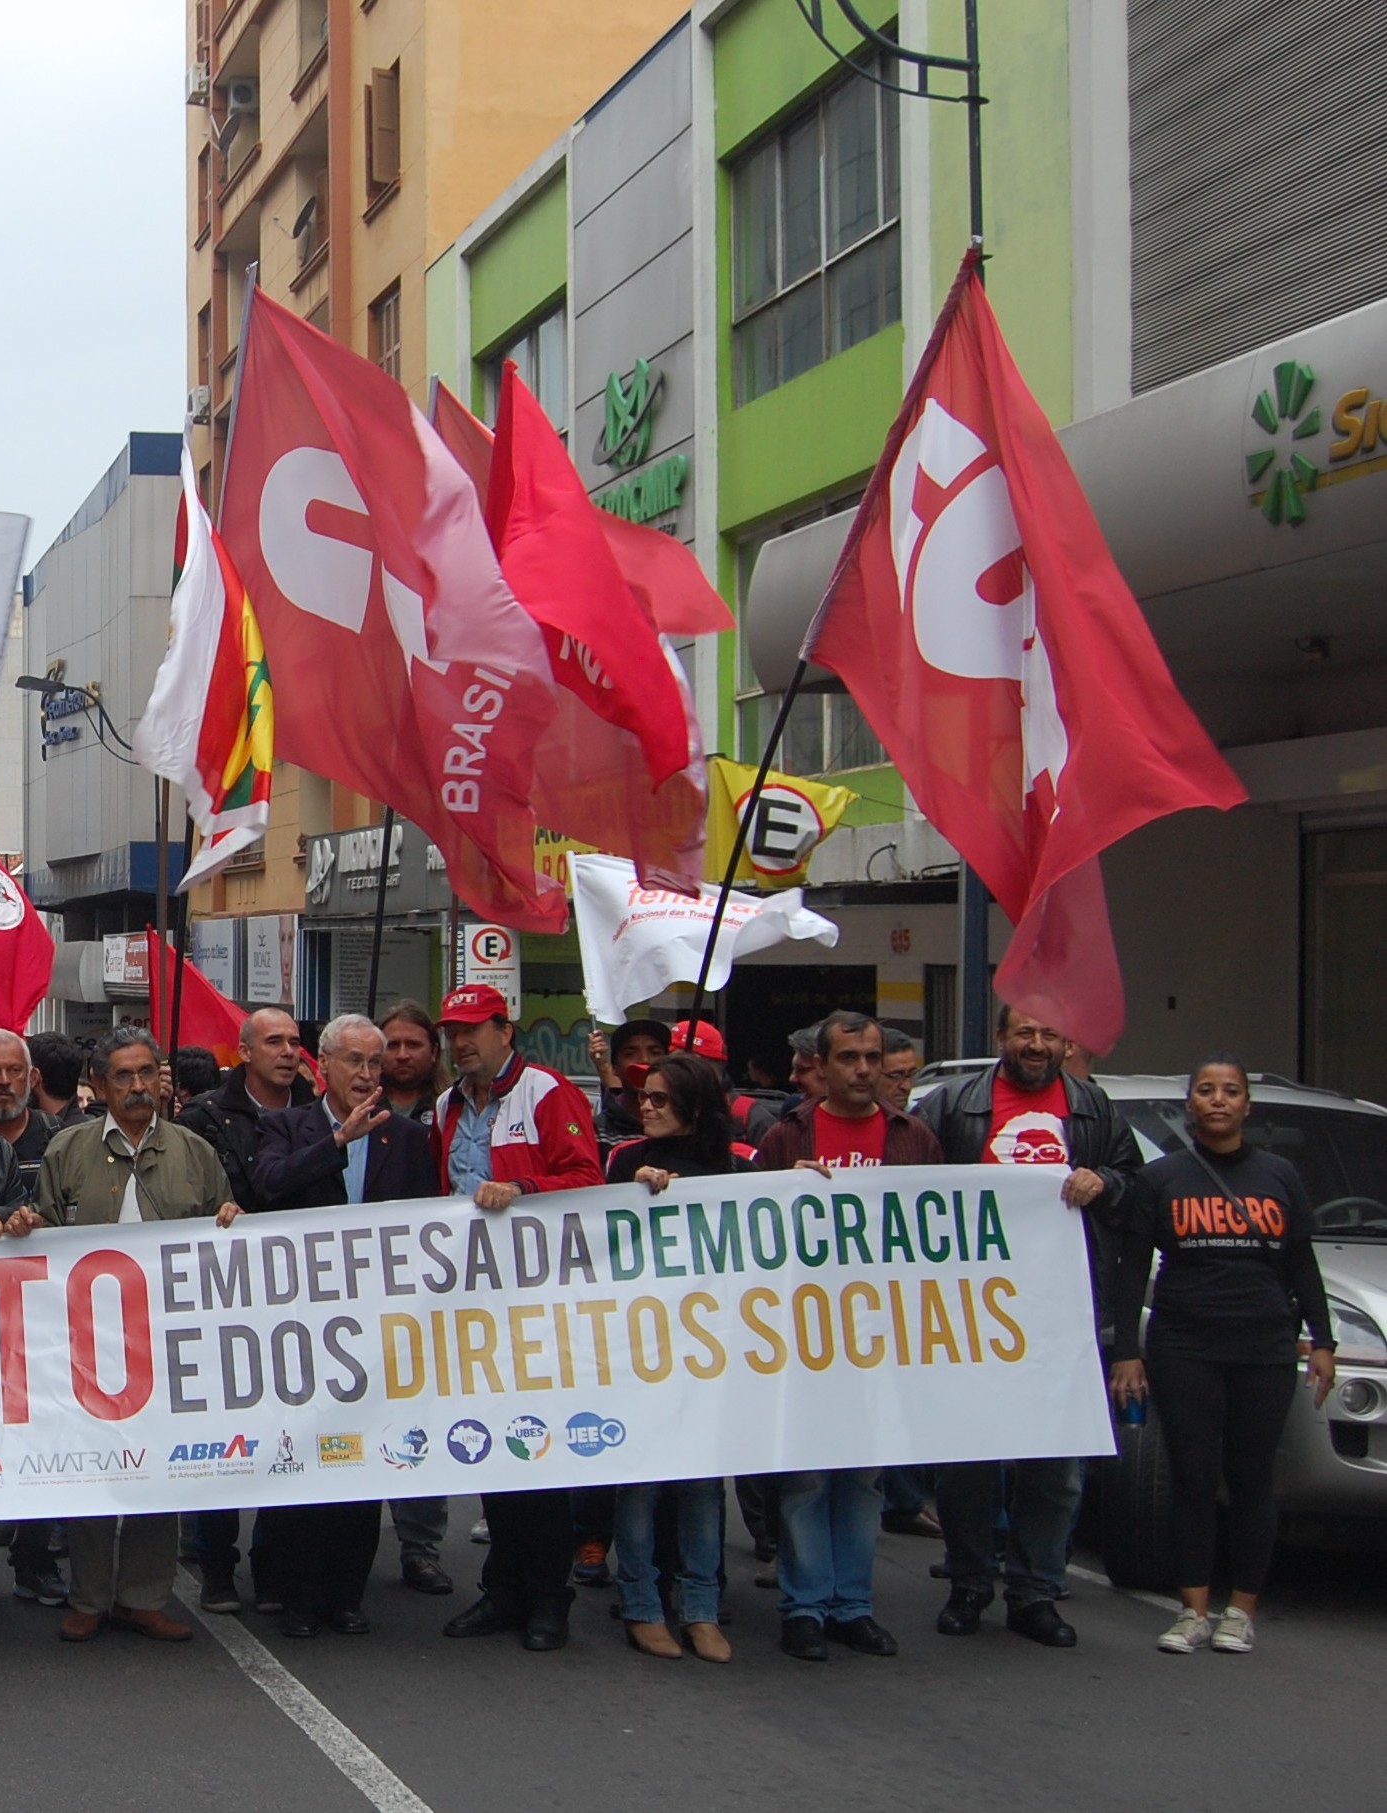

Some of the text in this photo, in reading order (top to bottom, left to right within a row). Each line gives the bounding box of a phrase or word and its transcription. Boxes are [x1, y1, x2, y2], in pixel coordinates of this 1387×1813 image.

[1329, 386, 1387, 463] SI
[751, 797, 802, 860] E
[346, 873, 400, 890] TECNOLGIA
[485, 936, 498, 958] E
[1172, 1196, 1284, 1236] UNEGRO
[161, 1189, 1012, 1313] EM DEFESA DA DEMOCRACIA
[166, 1277, 1027, 1414] E DOS DIREITOS SOCIAIS
[168, 1434, 260, 1462] ABRAT
[462, 1435, 480, 1444] UNE
[515, 1428, 544, 1438] UBES
